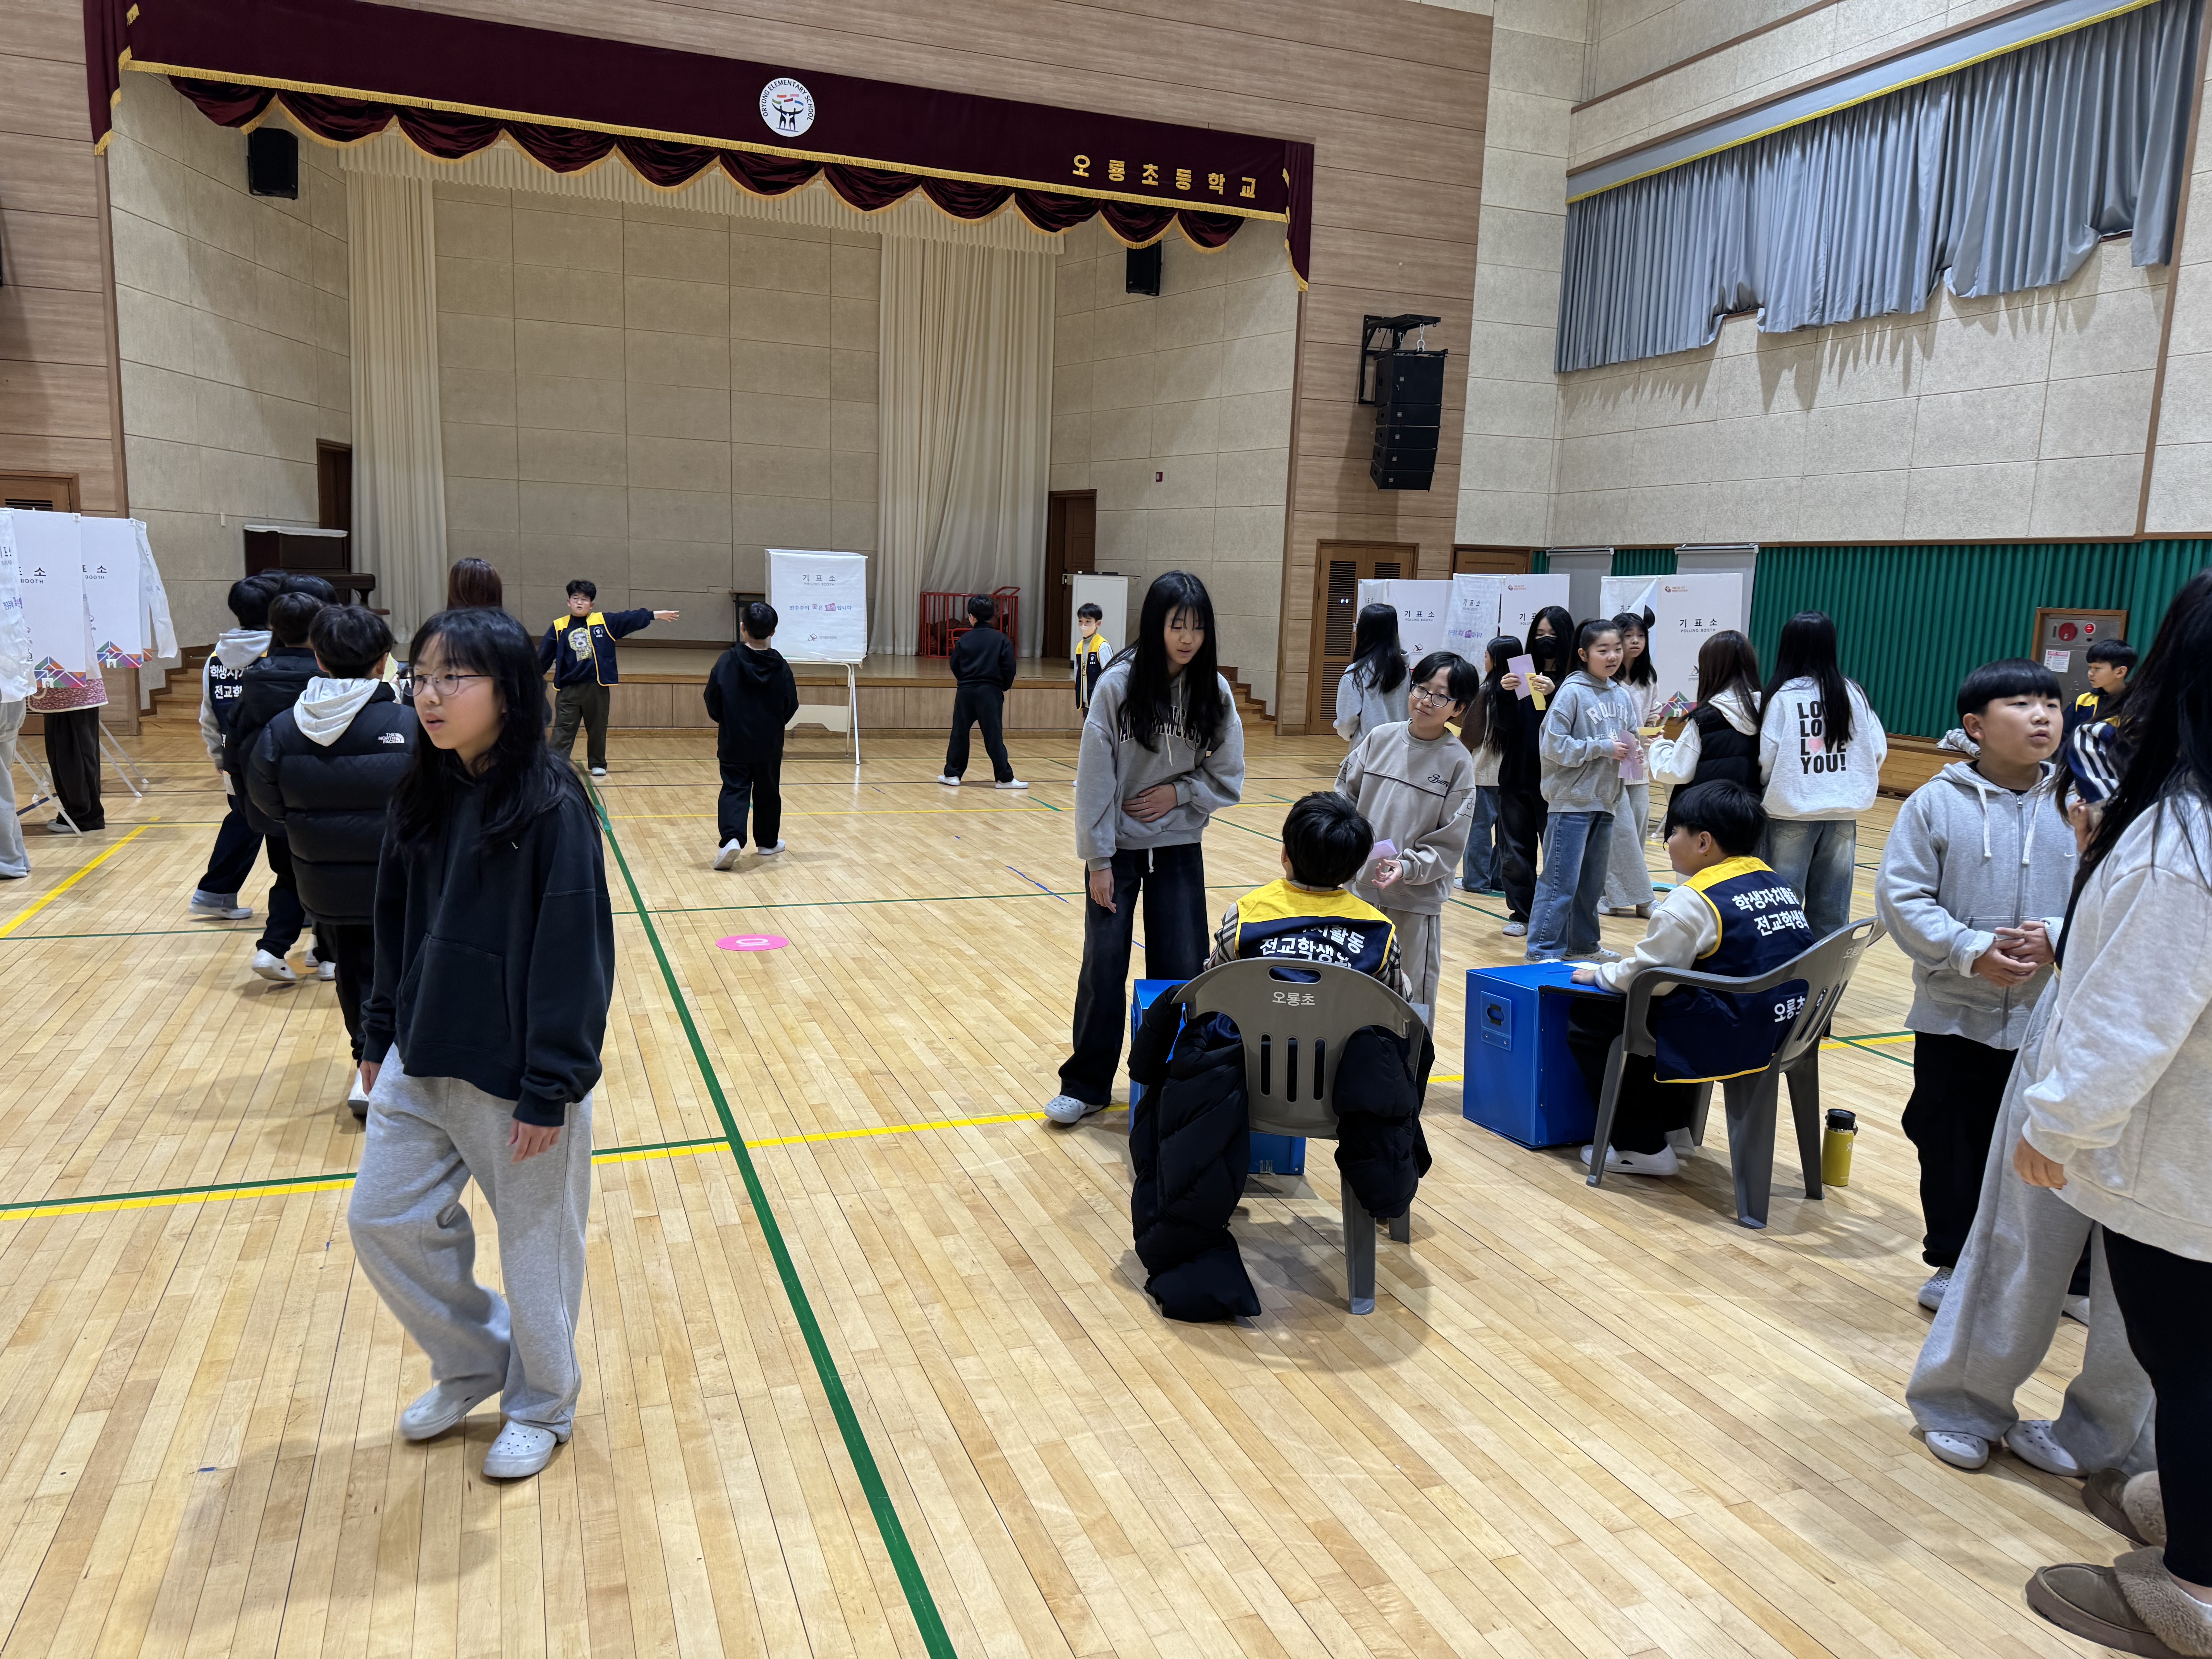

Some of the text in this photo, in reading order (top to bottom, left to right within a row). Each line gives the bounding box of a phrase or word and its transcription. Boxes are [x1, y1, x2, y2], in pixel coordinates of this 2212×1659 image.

[761, 79, 814, 120] ORYONG ELEMENTARY SCHOOL
[1072, 155, 1256, 199] 오룡초등학교
[1679, 618, 1718, 628] 기표소
[214, 685, 242, 699] 전교학
[1800, 754, 1846, 774] YOU!
[1272, 991, 1315, 1006] 오룡초
